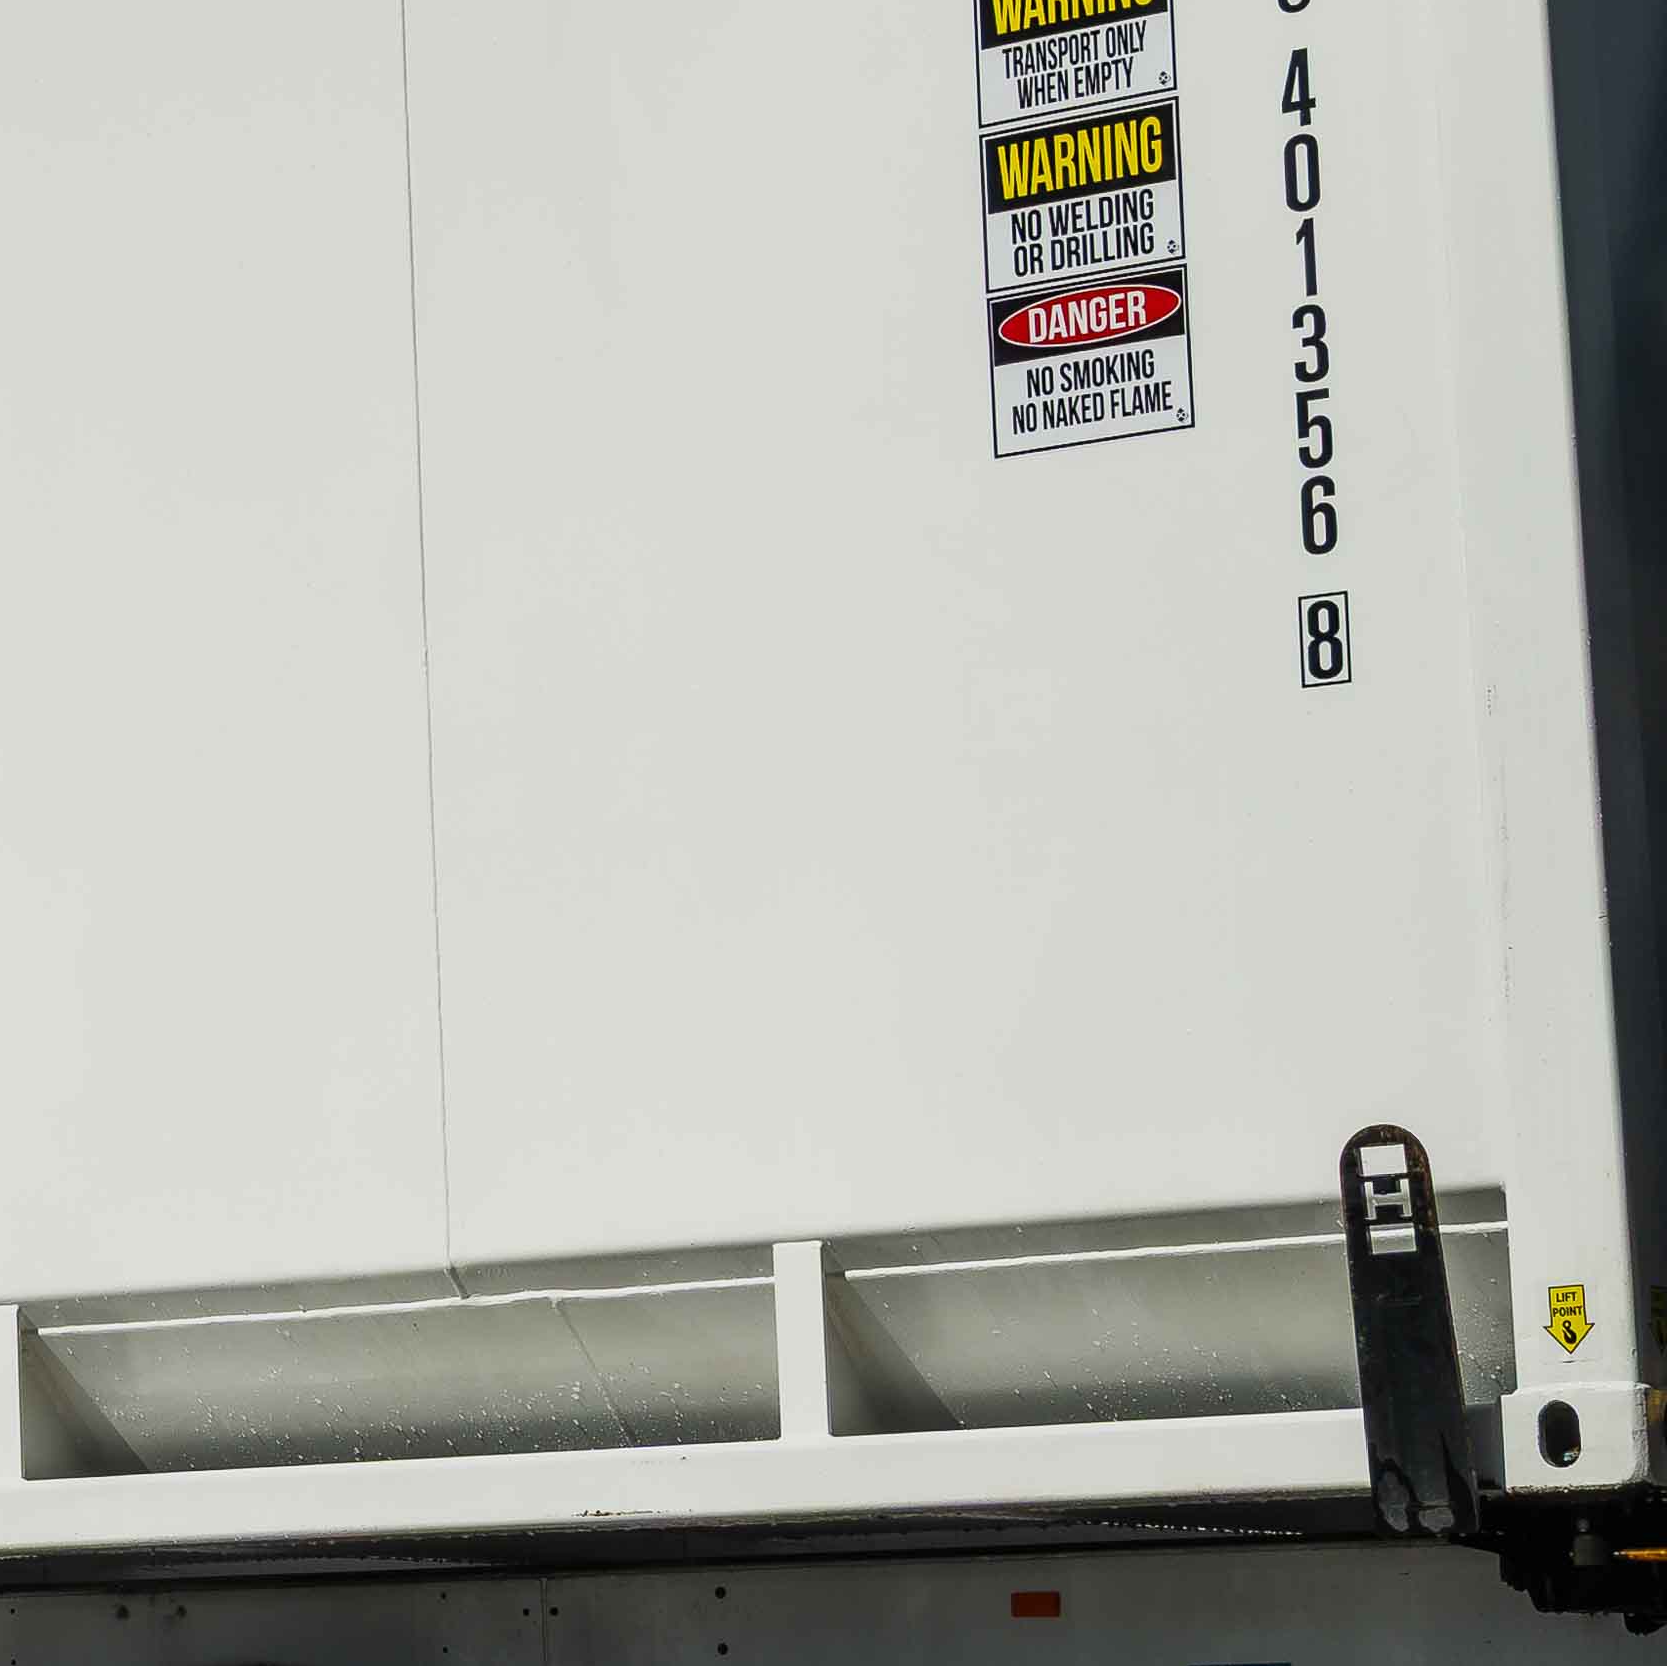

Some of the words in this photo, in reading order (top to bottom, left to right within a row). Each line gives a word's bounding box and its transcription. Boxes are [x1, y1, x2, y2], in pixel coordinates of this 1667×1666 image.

[1002, 30, 1101, 79] TRANSPORT
[1106, 20, 1147, 58] ONLY
[1017, 69, 1068, 110] WHEN
[1074, 56, 1134, 98] EMPTY
[997, 116, 1163, 200] WARNING
[1011, 209, 1042, 245] NO
[1048, 189, 1154, 237] WELDING
[1014, 243, 1044, 277] OR
[1051, 223, 1154, 271] DRILLING
[1028, 290, 1147, 344] DANGER
[1026, 366, 1054, 399] NO
[1059, 349, 1155, 393] SMOKING
[1012, 402, 1038, 436] NO
[1042, 392, 1104, 430] NAKED
[1110, 381, 1173, 419] FLAME
[1307, 599, 1343, 680] 8
[1553, 1306, 1583, 1318] POINT
[1556, 1292, 1577, 1303] LIFT
